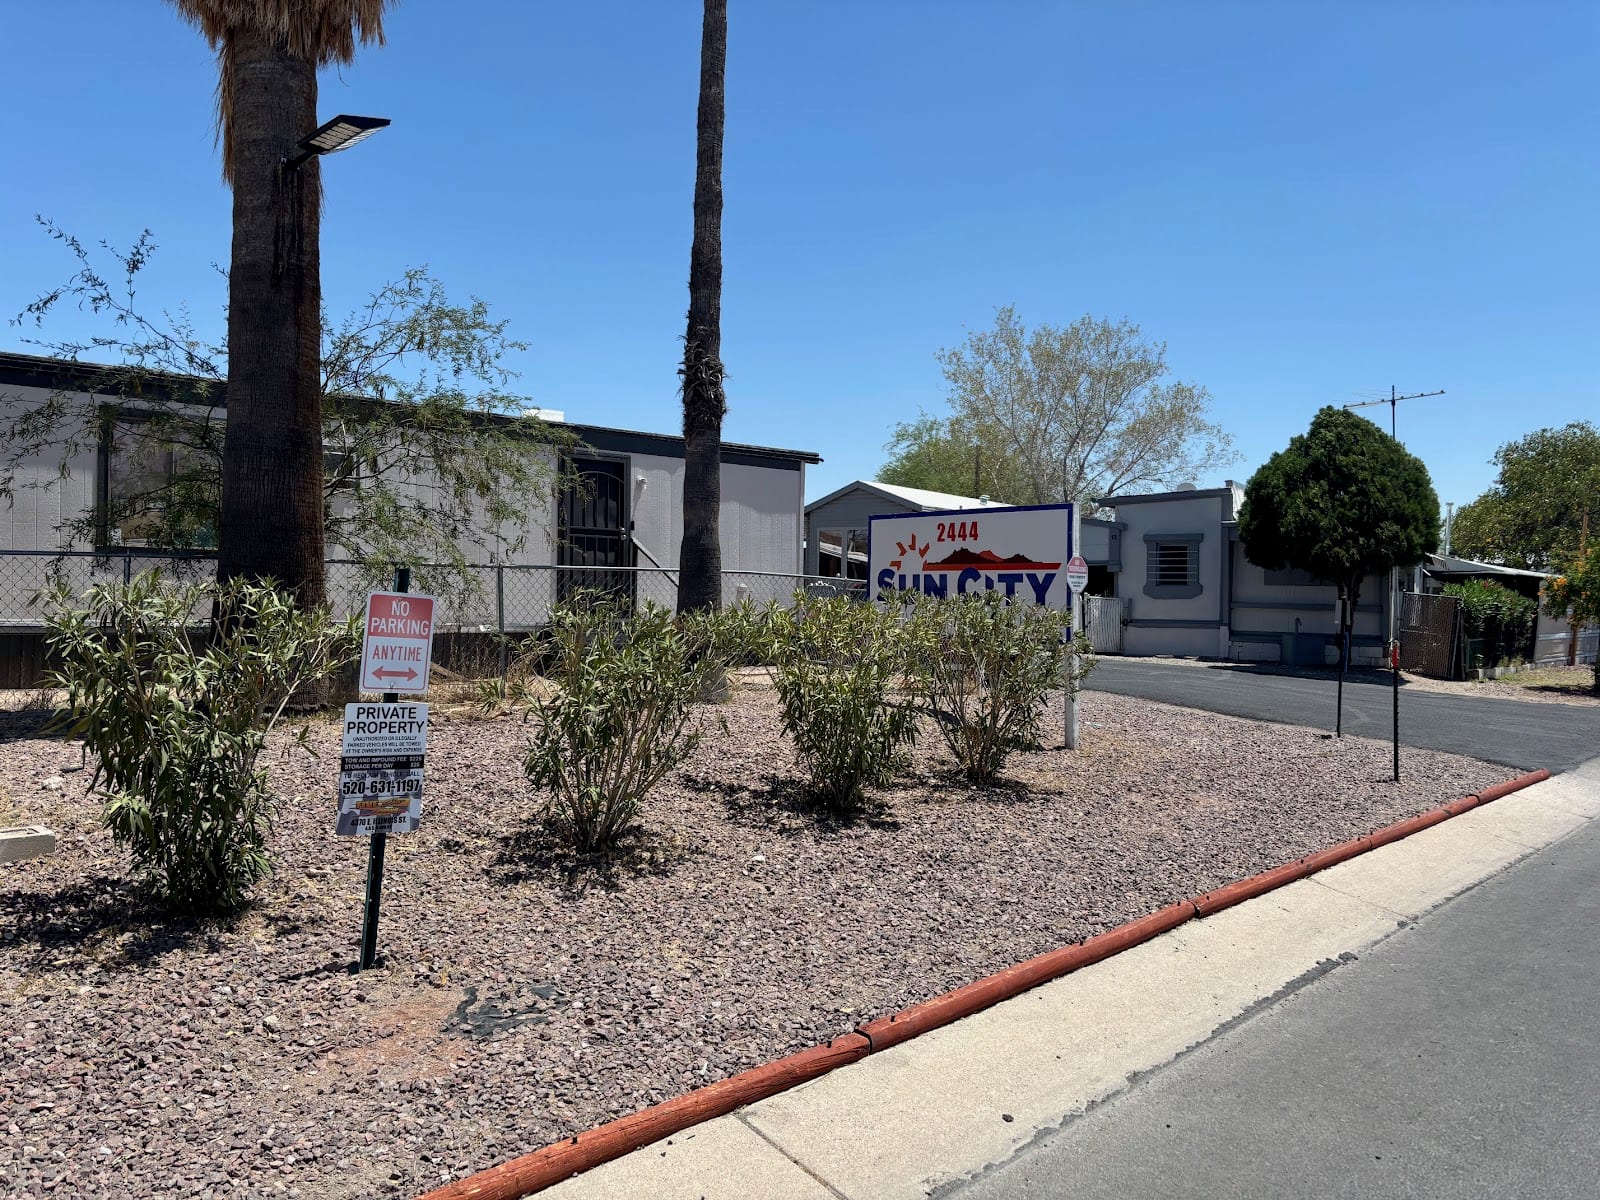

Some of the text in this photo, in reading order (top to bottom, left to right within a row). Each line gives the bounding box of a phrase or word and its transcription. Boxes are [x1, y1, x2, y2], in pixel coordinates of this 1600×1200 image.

[937, 521, 979, 542] 2444
[391, 600, 410, 617] NO
[370, 617, 430, 636] PARKING
[372, 644, 423, 662] ANYTIME
[356, 706, 417, 720] PRIVATE
[347, 720, 425, 734] PROPERTY
[342, 779, 420, 795] 520-631-1197
